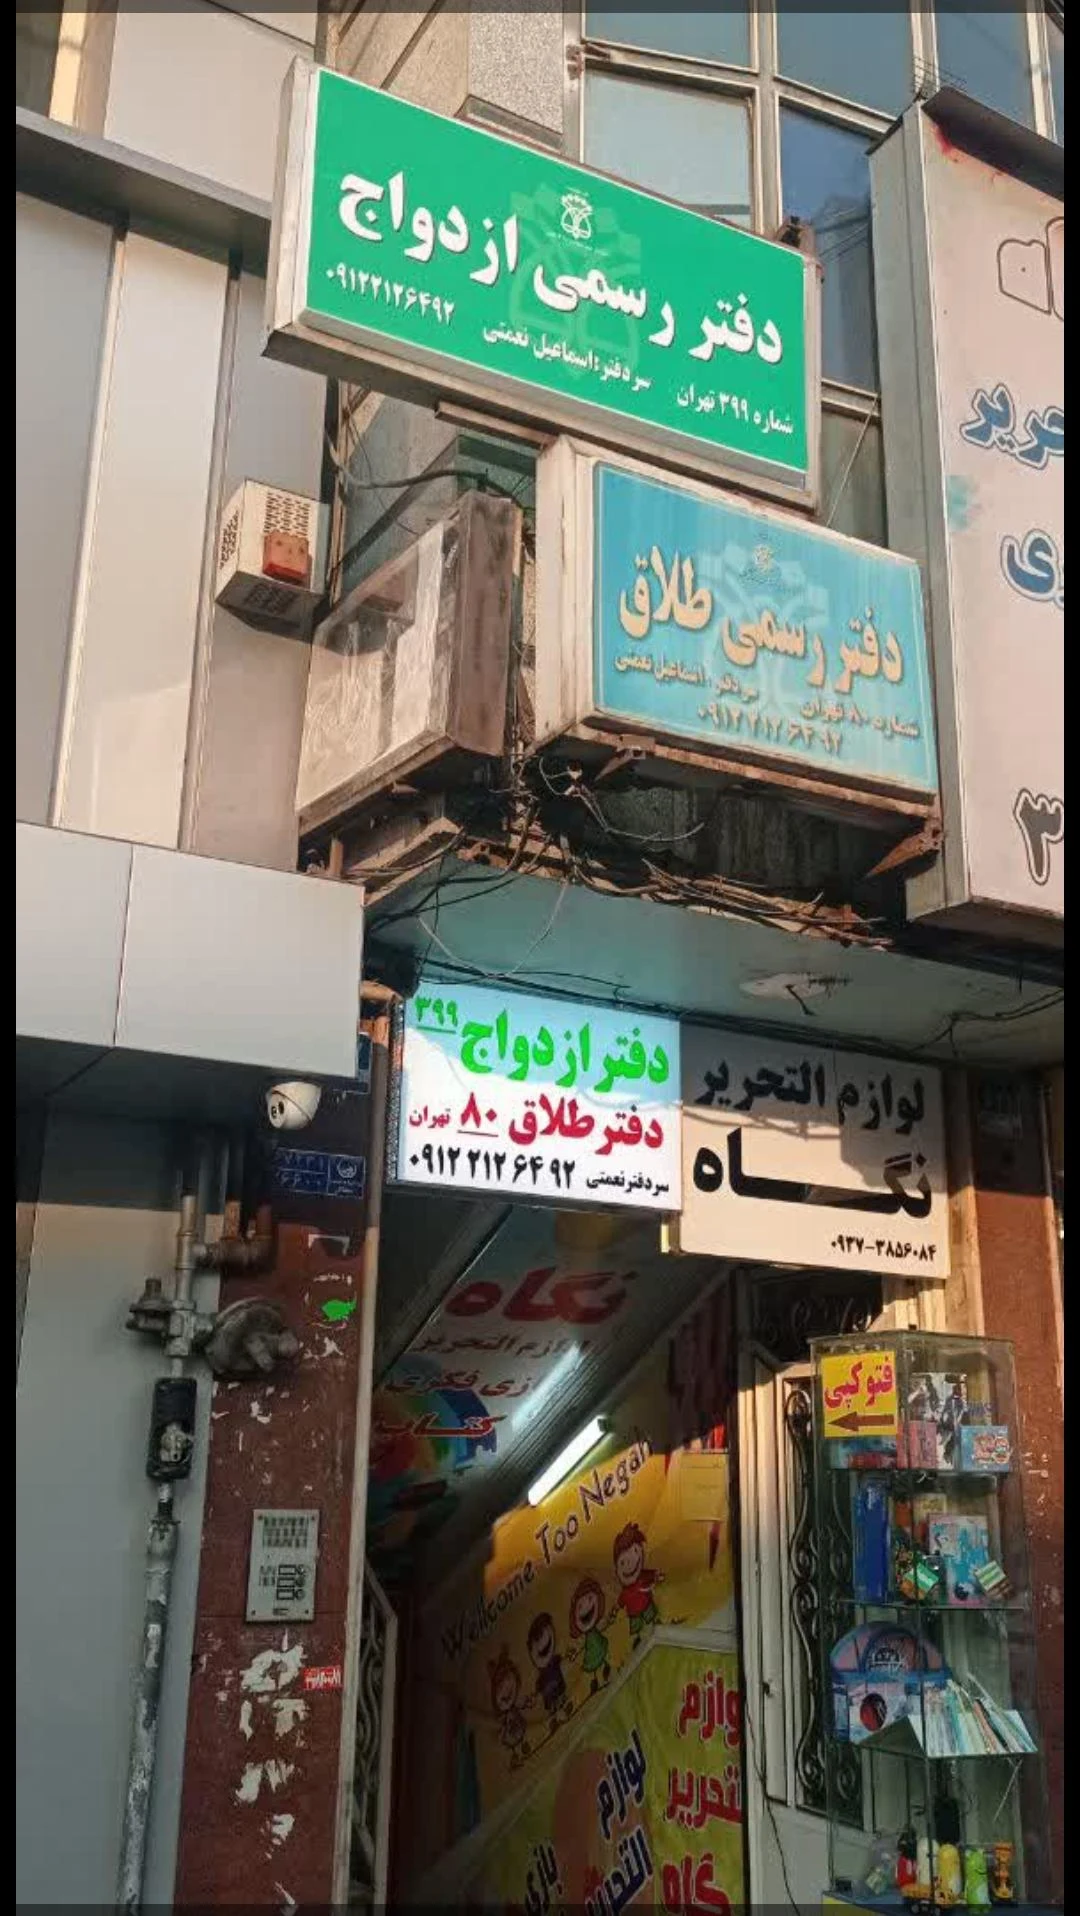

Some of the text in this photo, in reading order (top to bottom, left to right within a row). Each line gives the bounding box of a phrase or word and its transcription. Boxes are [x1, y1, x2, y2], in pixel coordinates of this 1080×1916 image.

[326, 262, 455, 326] ۰۹۱۲۲۱۲۶۴۹۲
[339, 171, 783, 364] دفتر رسمی ازدواج
[483, 322, 528, 348] نعمتی
[676, 382, 794, 434] شماره ۳۹۹ تهران
[619, 545, 904, 695] دفتر رسمی طلاق
[800, 696, 920, 739] شماره ۸۰ تهران
[415, 996, 669, 1093] دفتر ازدواج ۳۹۹
[409, 1092, 665, 1155] دفتر طلاق ۸۰ تهران
[694, 1060, 925, 1135] لوازم التحریر
[586, 1170, 625, 1189] نعمتی
[535, 1513, 580, 1565] Too
[579, 1432, 654, 1523] Negah
